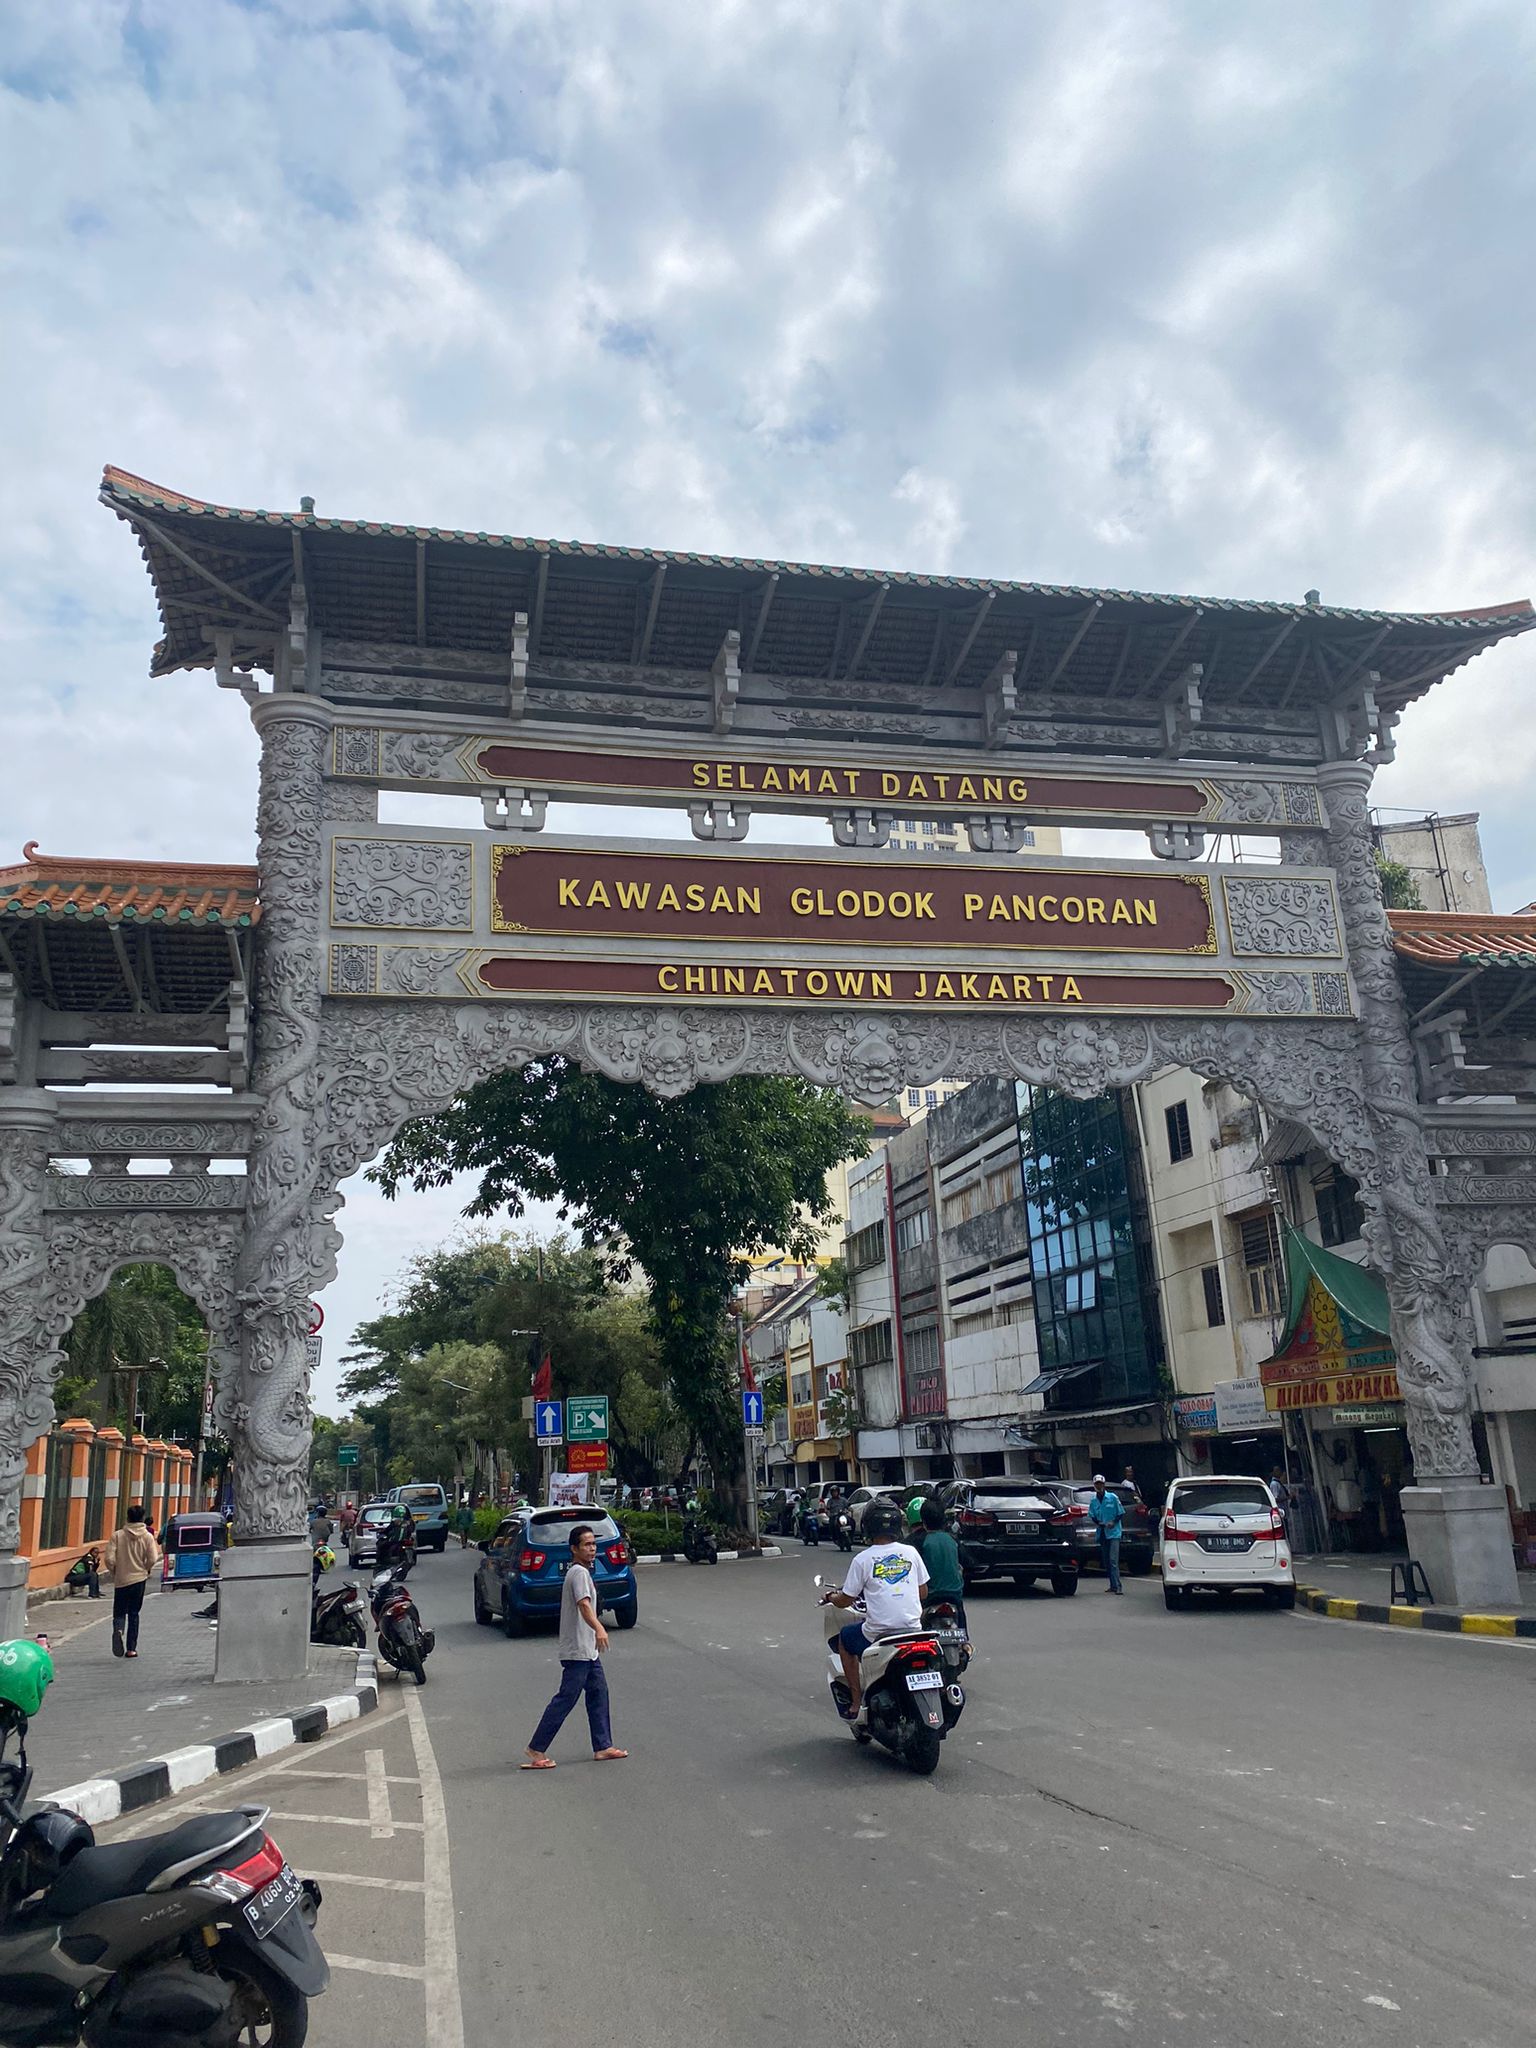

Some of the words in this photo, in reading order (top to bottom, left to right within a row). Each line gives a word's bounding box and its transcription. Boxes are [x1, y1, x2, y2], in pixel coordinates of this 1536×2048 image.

[692, 763, 862, 794] SELAMAT
[881, 773, 1029, 801] DATANG
[559, 878, 761, 914] KAWASAN
[791, 887, 936, 919] GLODOK
[964, 894, 1157, 925] PANCORAN
[657, 966, 893, 998] CHINATOWN
[915, 973, 1084, 1001] JAKARTA
[1180, 1400, 1196, 1413] TOKO
[1196, 1398, 1213, 1411] OBAT
[1276, 1382, 1328, 1408] MINANG
[575, 1413, 584, 1427] P
[248, 1906, 260, 1921] B
[260, 1880, 283, 1908] 4060
